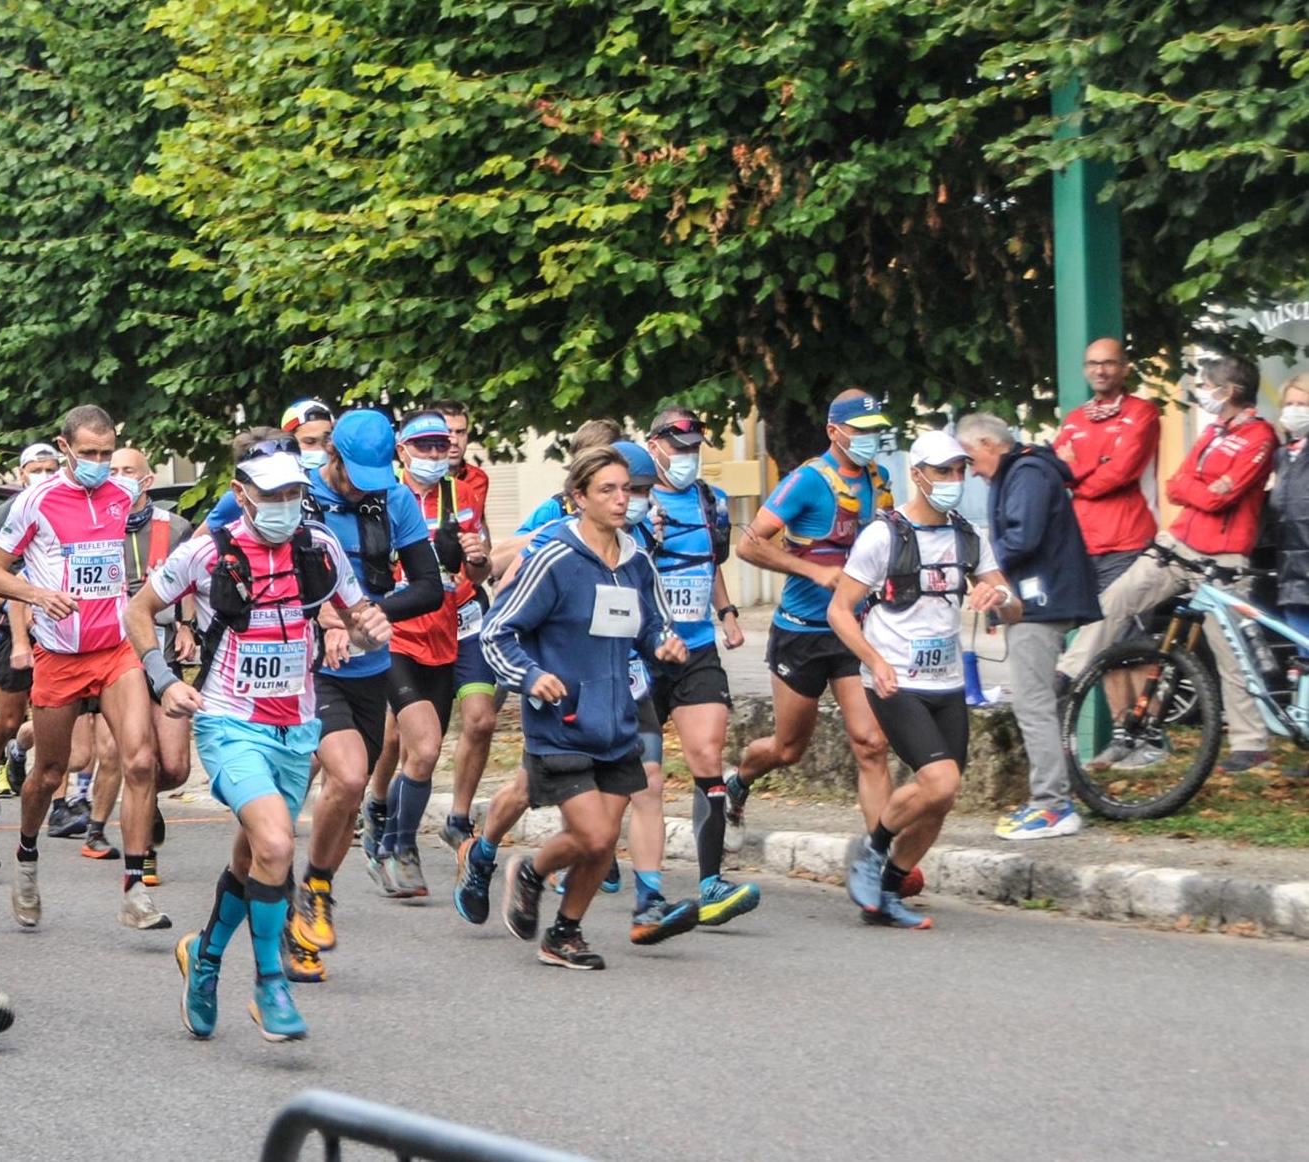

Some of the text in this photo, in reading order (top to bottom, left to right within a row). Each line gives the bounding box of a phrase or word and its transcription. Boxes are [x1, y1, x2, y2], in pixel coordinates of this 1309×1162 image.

[75, 566, 103, 584] 152
[84, 585, 111, 593] ULTIME
[241, 644, 266, 654] TRAIL
[914, 648, 942, 667] 419
[240, 656, 281, 679] 460
[254, 680, 290, 690] ULTIME
